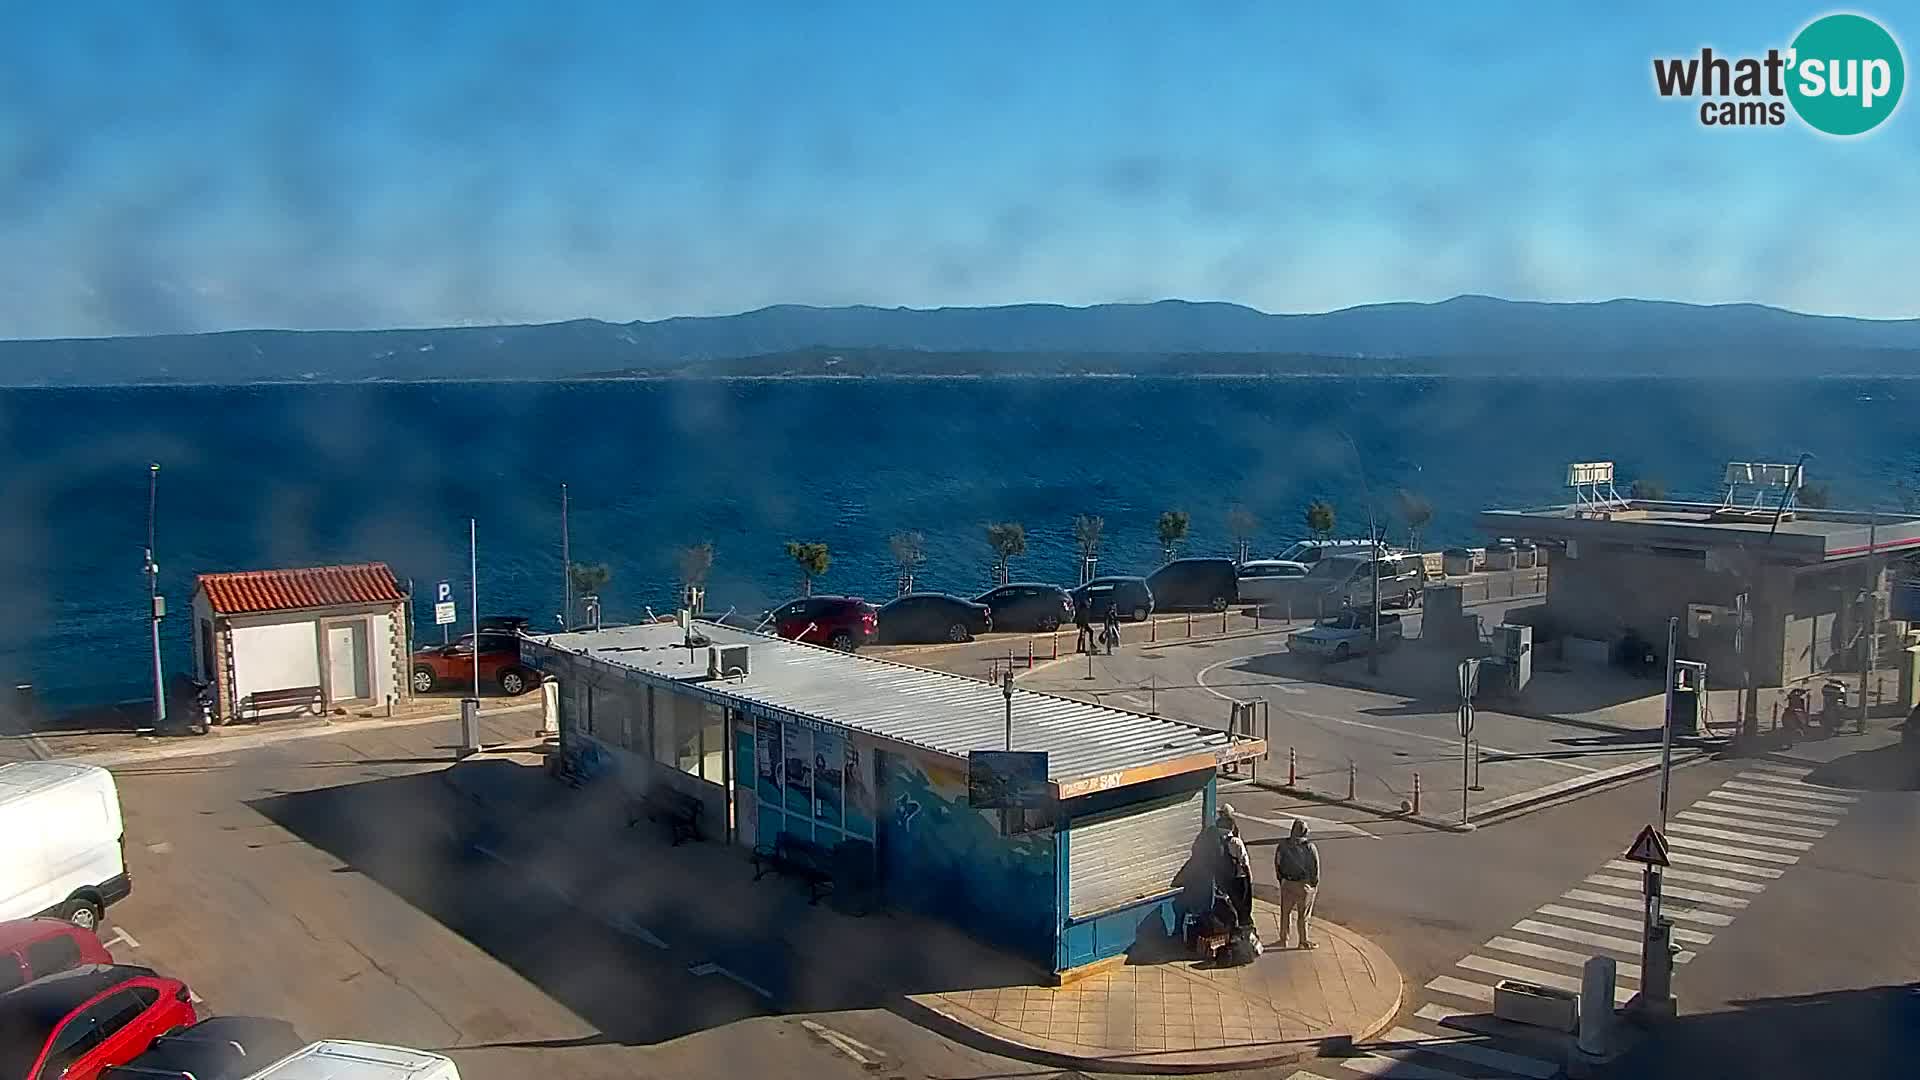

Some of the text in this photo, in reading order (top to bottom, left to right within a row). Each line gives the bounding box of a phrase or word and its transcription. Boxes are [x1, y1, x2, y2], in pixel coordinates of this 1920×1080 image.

[439, 583, 450, 601] P
[765, 708, 795, 723] STATION
[799, 717, 821, 732] TICKET
[823, 724, 849, 738] OFFICE
